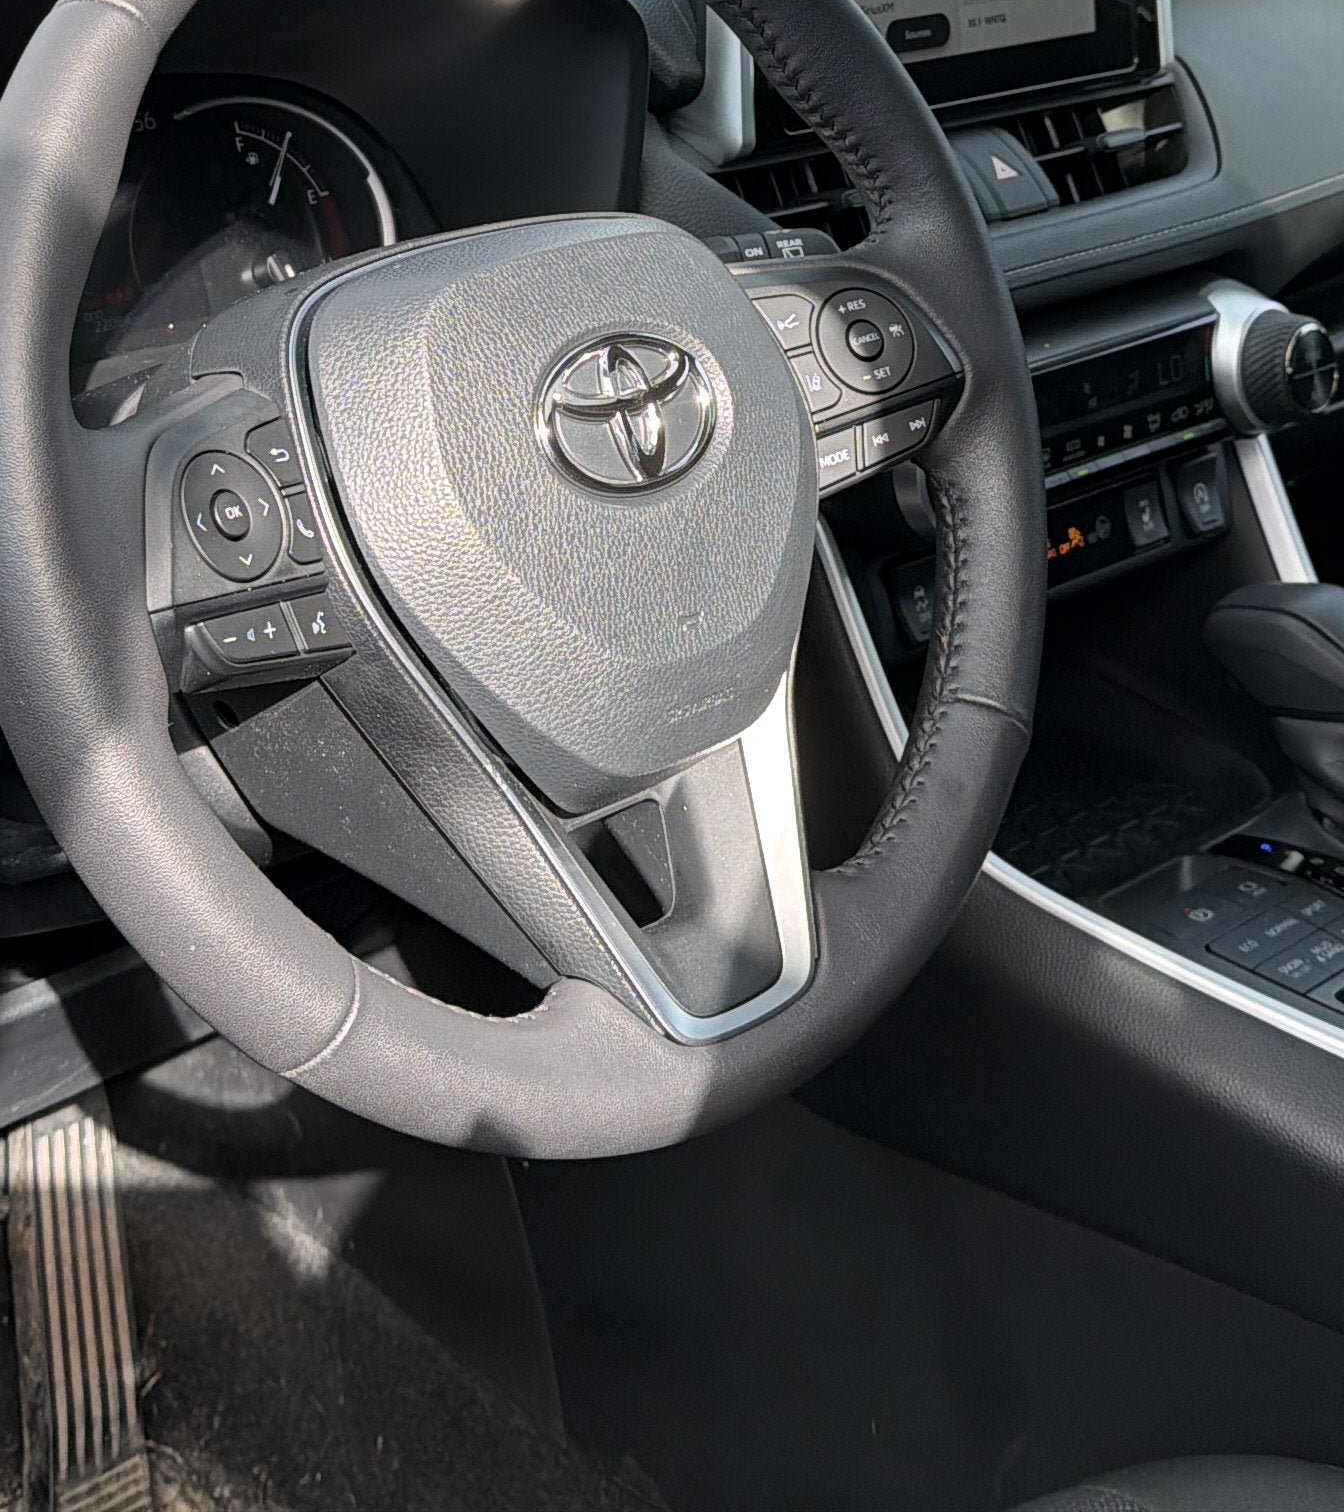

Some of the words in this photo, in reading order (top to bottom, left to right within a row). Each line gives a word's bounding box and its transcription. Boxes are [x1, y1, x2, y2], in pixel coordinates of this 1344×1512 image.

[234, 137, 245, 153] F
[306, 189, 317, 205] E
[776, 238, 804, 248] REAR
[745, 247, 764, 258] ON
[852, 333, 880, 347] CANCEL
[819, 449, 850, 469] MODE
[225, 504, 244, 520] OK
